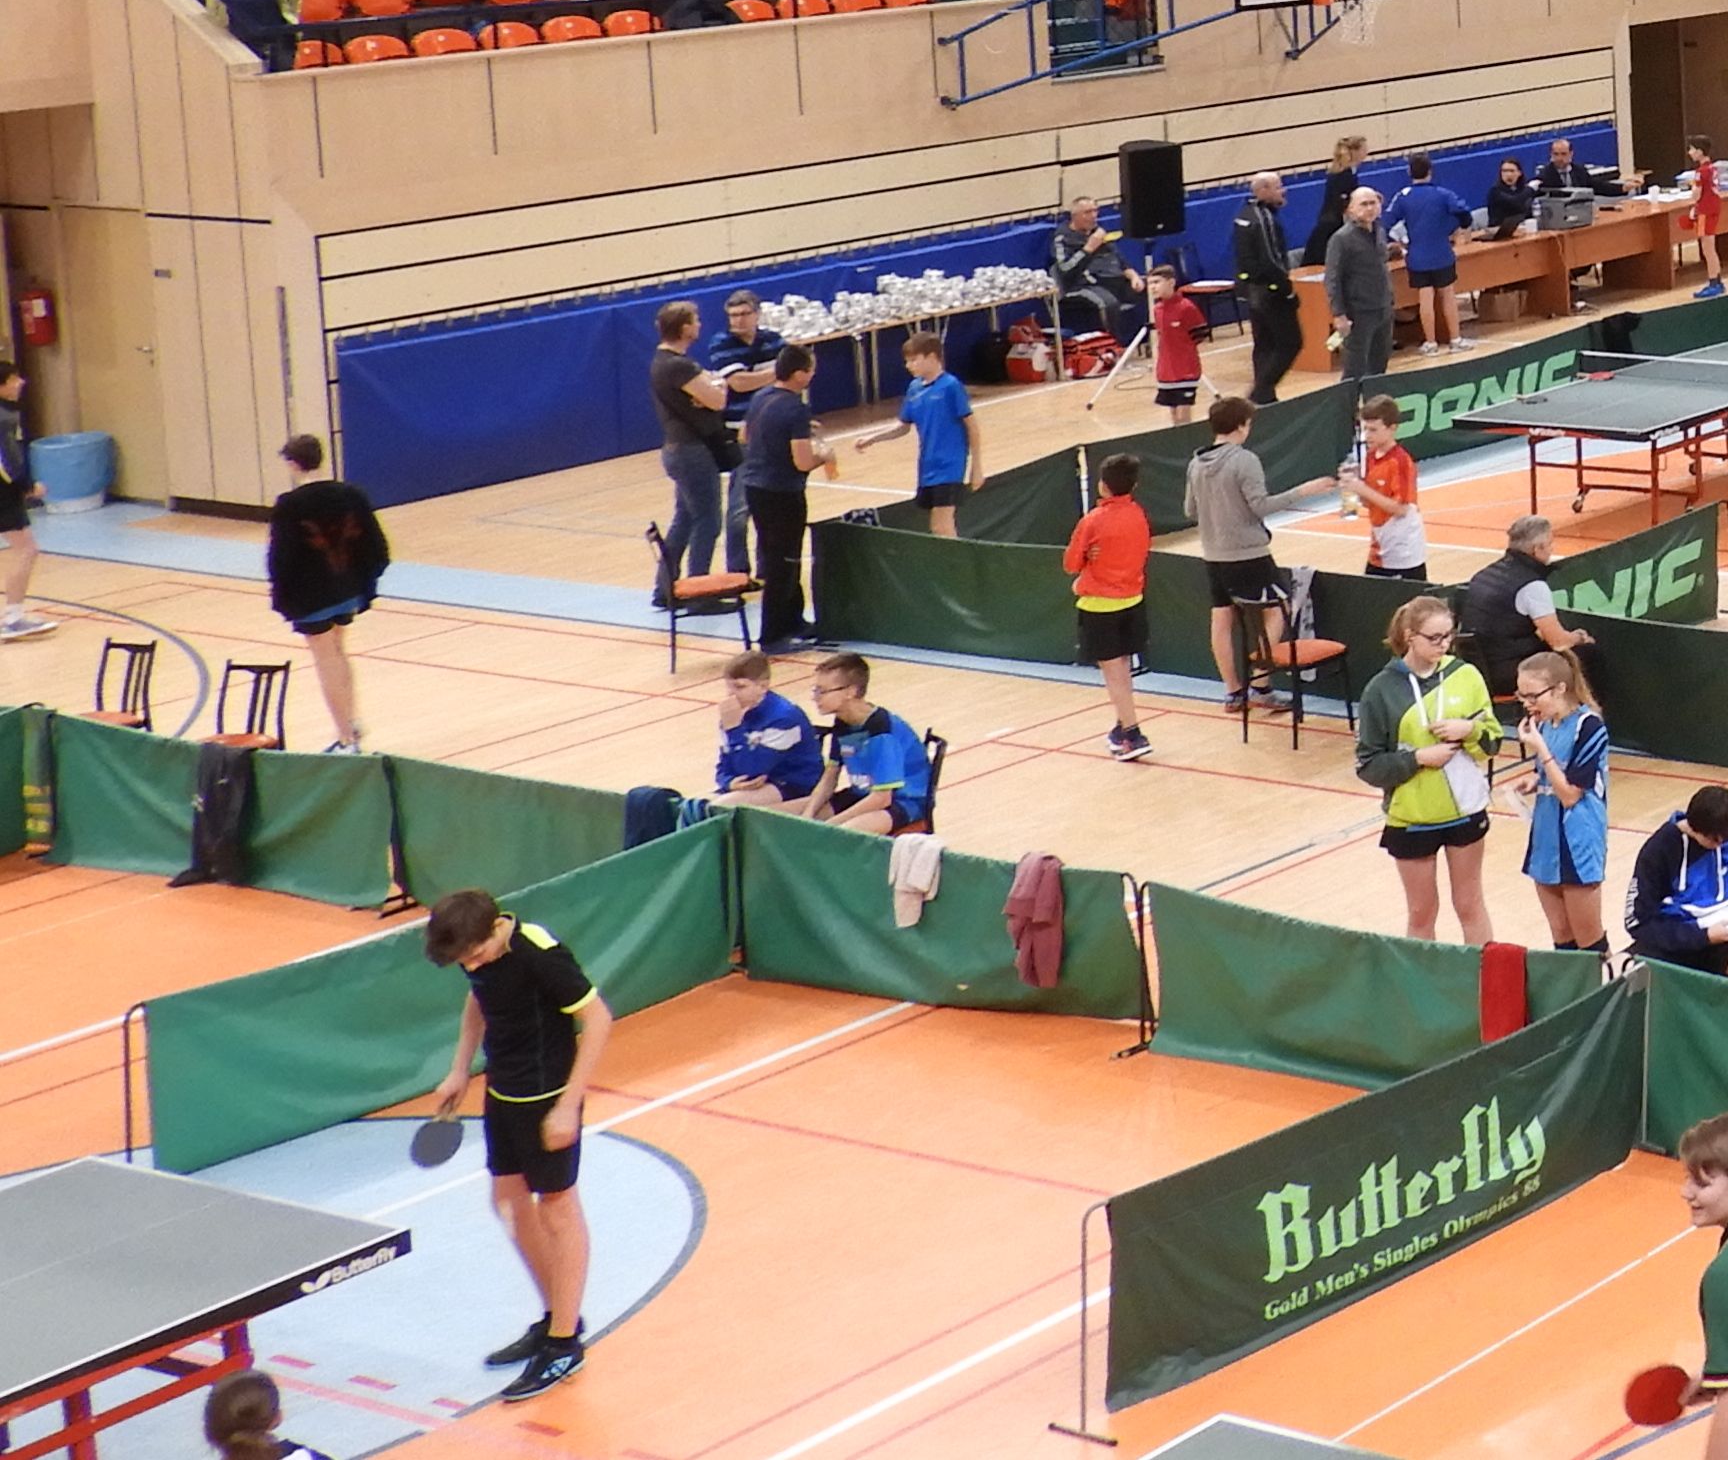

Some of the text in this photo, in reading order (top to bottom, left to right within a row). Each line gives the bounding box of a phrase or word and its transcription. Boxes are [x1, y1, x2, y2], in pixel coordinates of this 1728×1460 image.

[1255, 1094, 1546, 1283] Butterfly
[331, 1245, 398, 1282] Butterfly
[1263, 1285, 1309, 1320] Gold
[1314, 1261, 1370, 1300] Men's
[1372, 1231, 1439, 1273] Singles
